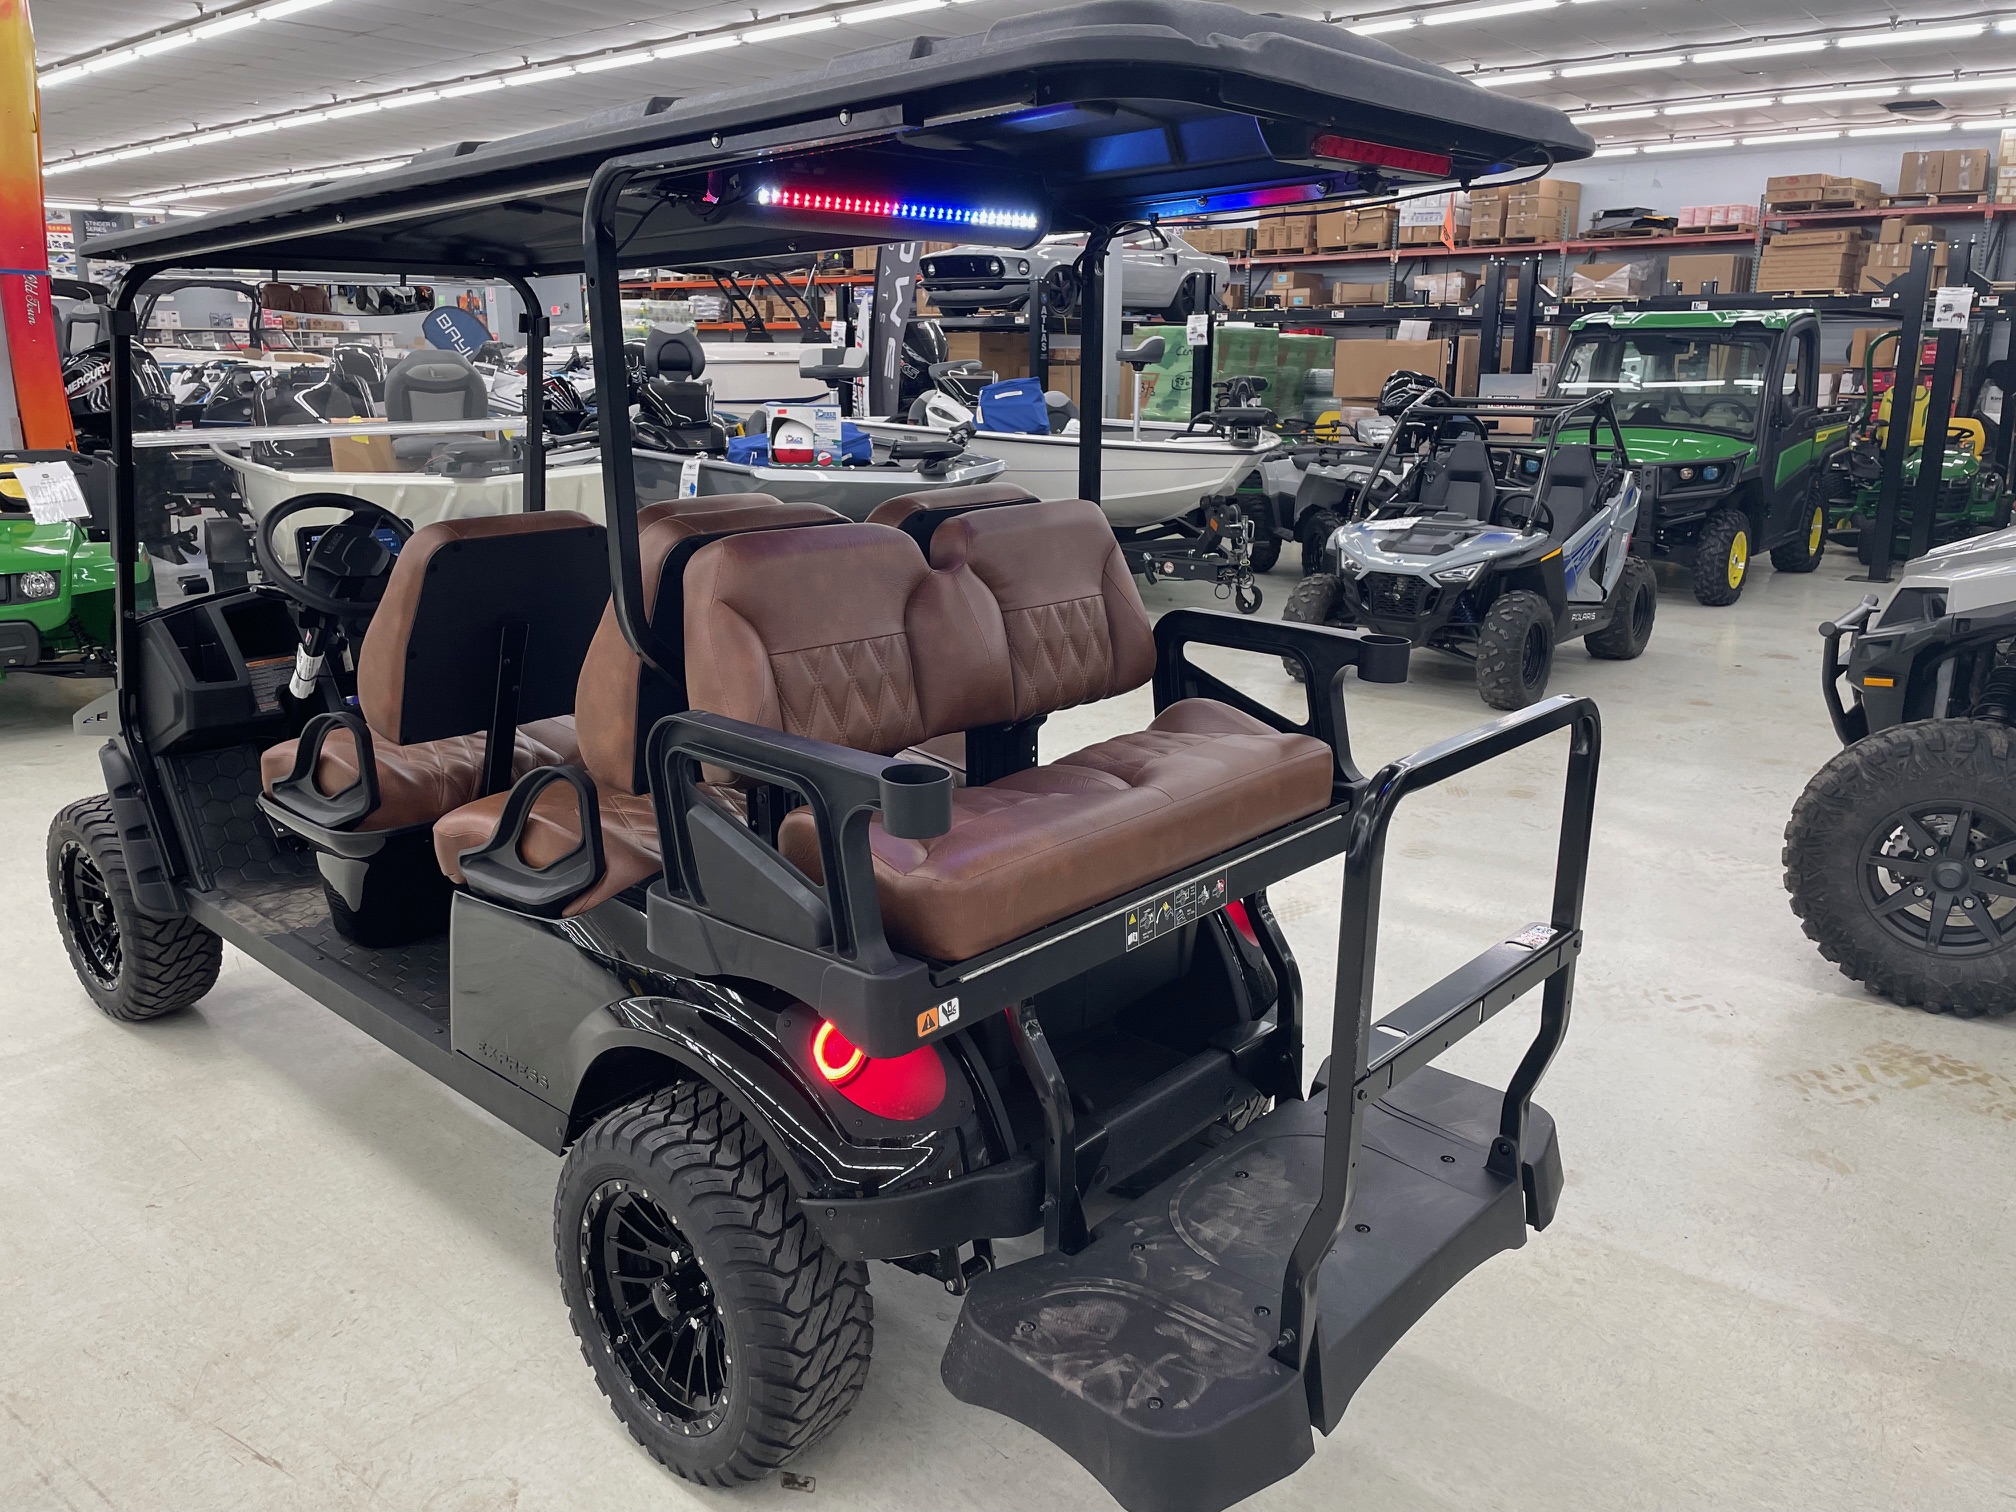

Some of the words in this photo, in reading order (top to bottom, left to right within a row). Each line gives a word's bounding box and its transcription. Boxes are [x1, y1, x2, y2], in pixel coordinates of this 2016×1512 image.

[25, 294, 41, 325] Town
[1040, 305, 1048, 352] ATLAS
[64, 361, 111, 395] MERCURY
[1571, 612, 1596, 622] POLARIS
